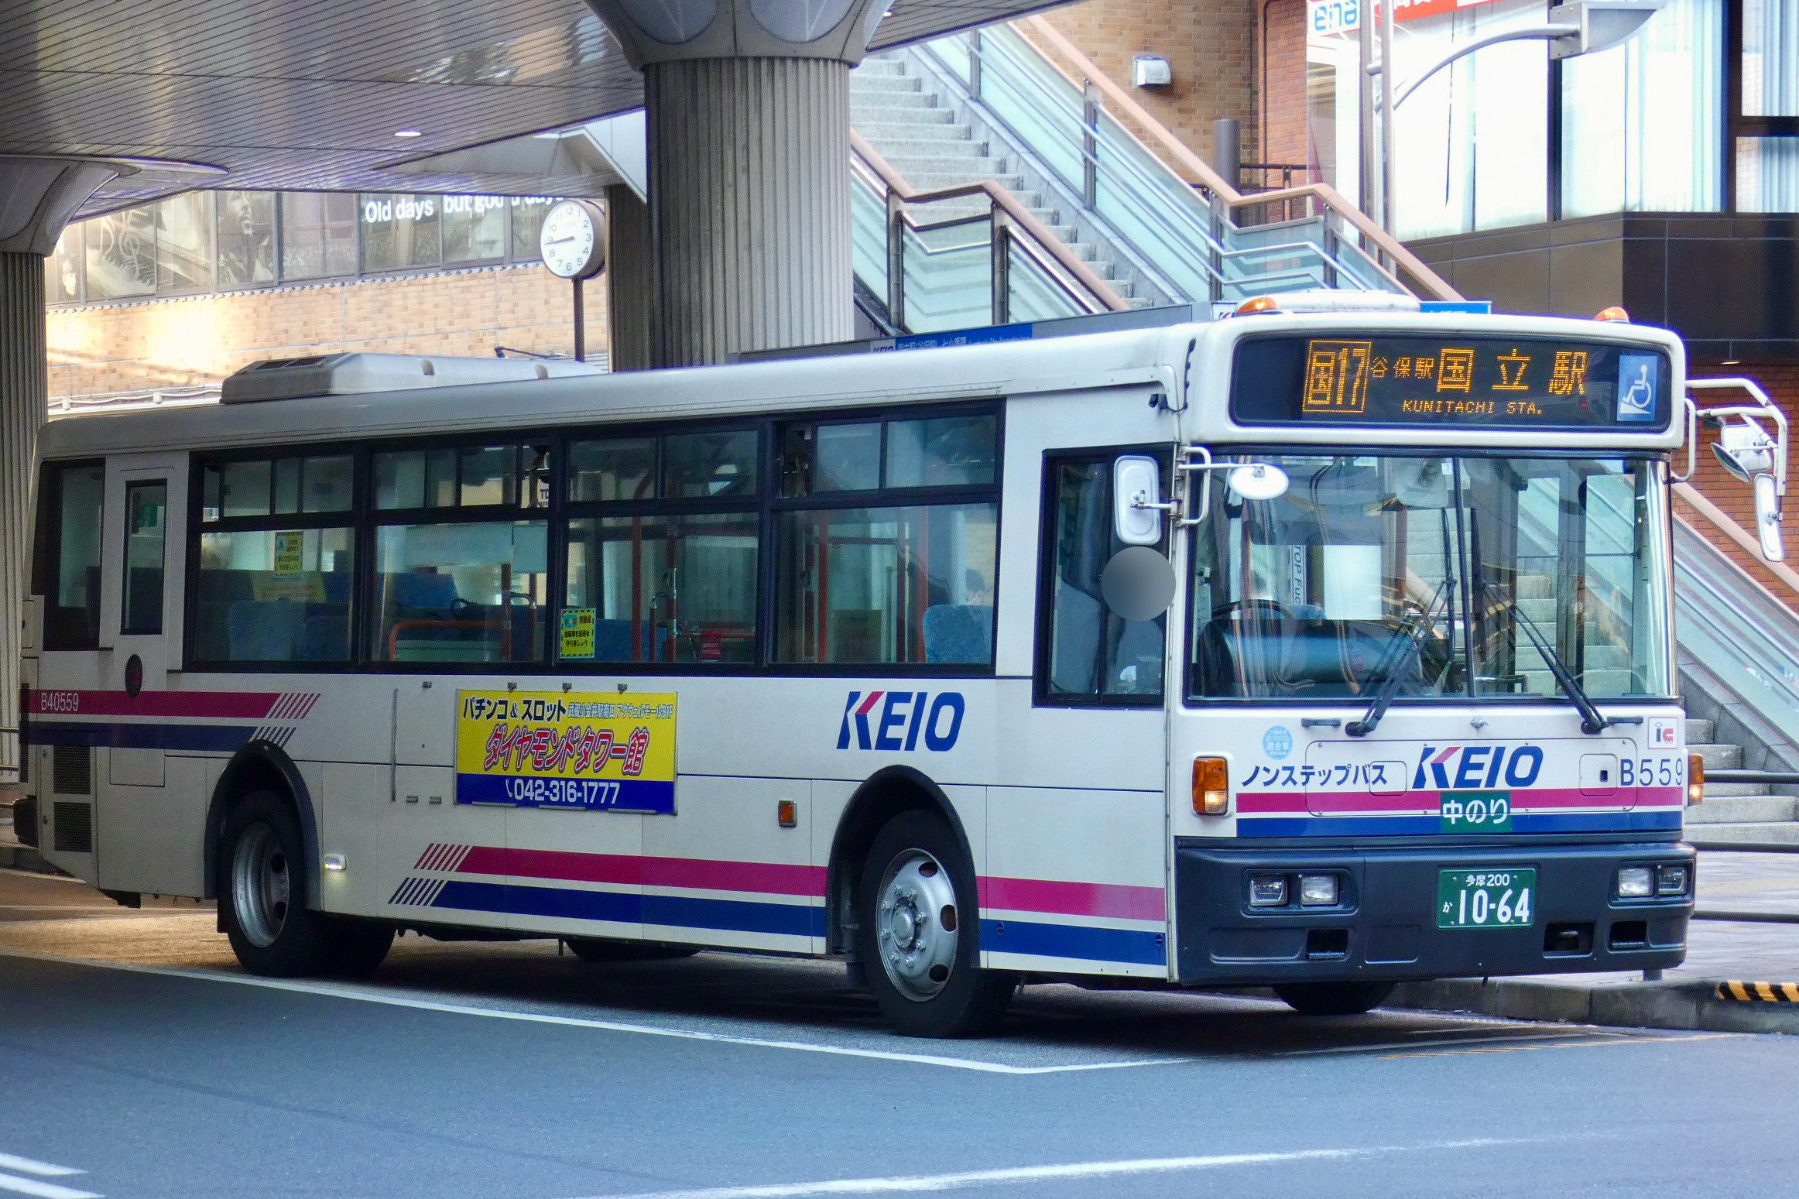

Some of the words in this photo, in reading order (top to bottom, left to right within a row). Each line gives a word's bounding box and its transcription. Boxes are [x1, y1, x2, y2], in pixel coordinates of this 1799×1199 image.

[365, 201, 392, 223] Old
[395, 199, 434, 220] days
[443, 195, 472, 213] but
[1370, 356, 1435, 379] 谷保駅
[1437, 348, 1588, 395] 国立駅
[1402, 399, 1495, 414] KUNITACHI
[1506, 401, 1543, 416] STA.
[41, 693, 79, 711] B40559
[836, 691, 965, 752] KEIO
[484, 723, 650, 777] ダイヤモンドタワー館
[1242, 764, 1388, 787] ノンステップバス
[1411, 746, 1544, 789] KEIO
[1620, 758, 1683, 787] B559
[513, 778, 621, 805] 042-316-1777
[1442, 798, 1508, 825] 中のり
[1442, 901, 1453, 913] か
[1458, 887, 1530, 924] 10-64
